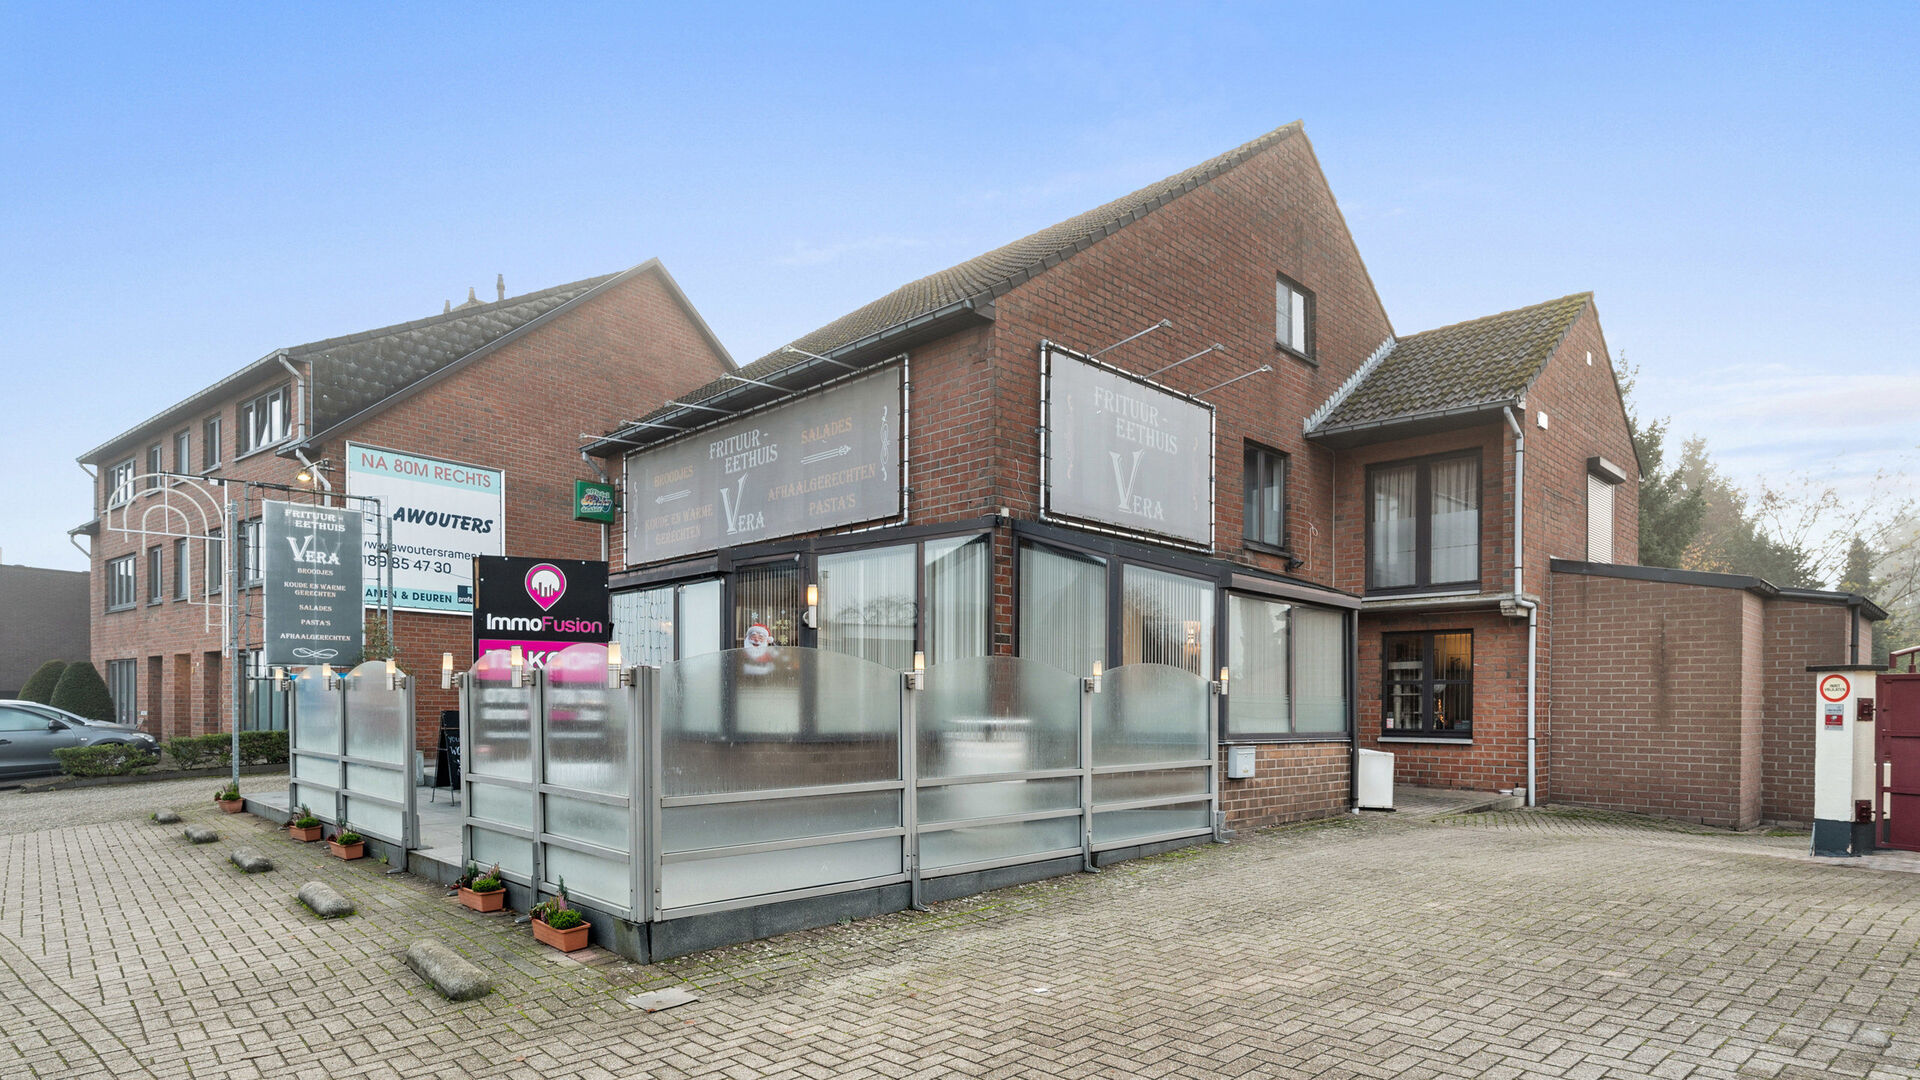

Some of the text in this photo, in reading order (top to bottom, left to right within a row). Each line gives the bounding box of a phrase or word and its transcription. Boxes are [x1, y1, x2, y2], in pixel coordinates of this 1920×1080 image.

[801, 416, 853, 445] SALADES
[1115, 417, 1178, 455] EETHUIS
[724, 443, 779, 474] EETHUIS
[361, 452, 492, 488] NA 80M RECHTS
[653, 464, 695, 489] BROODJES
[767, 463, 877, 502] AFHAALGERECHTEN
[682, 503, 714, 522] WARME
[808, 492, 857, 517] PASTA'S
[294, 519, 346, 532] EETHUIS
[393, 506, 494, 534] AWOUTERS
[655, 523, 701, 546] GERECHTEN
[297, 567, 334, 577] BROODJES
[363, 554, 452, 574] 89 85 47 30
[283, 581, 308, 589] KOUDE
[320, 583, 347, 592] WARME
[294, 589, 337, 598] GERECHTEN
[401, 591, 409, 600] &
[412, 592, 452, 603] DEUREN
[298, 604, 333, 612] SALADES
[300, 618, 331, 627] PASTA'S
[486, 613, 603, 634] ImmoFusion
[280, 632, 352, 642] AFHAALGERECHTEN
